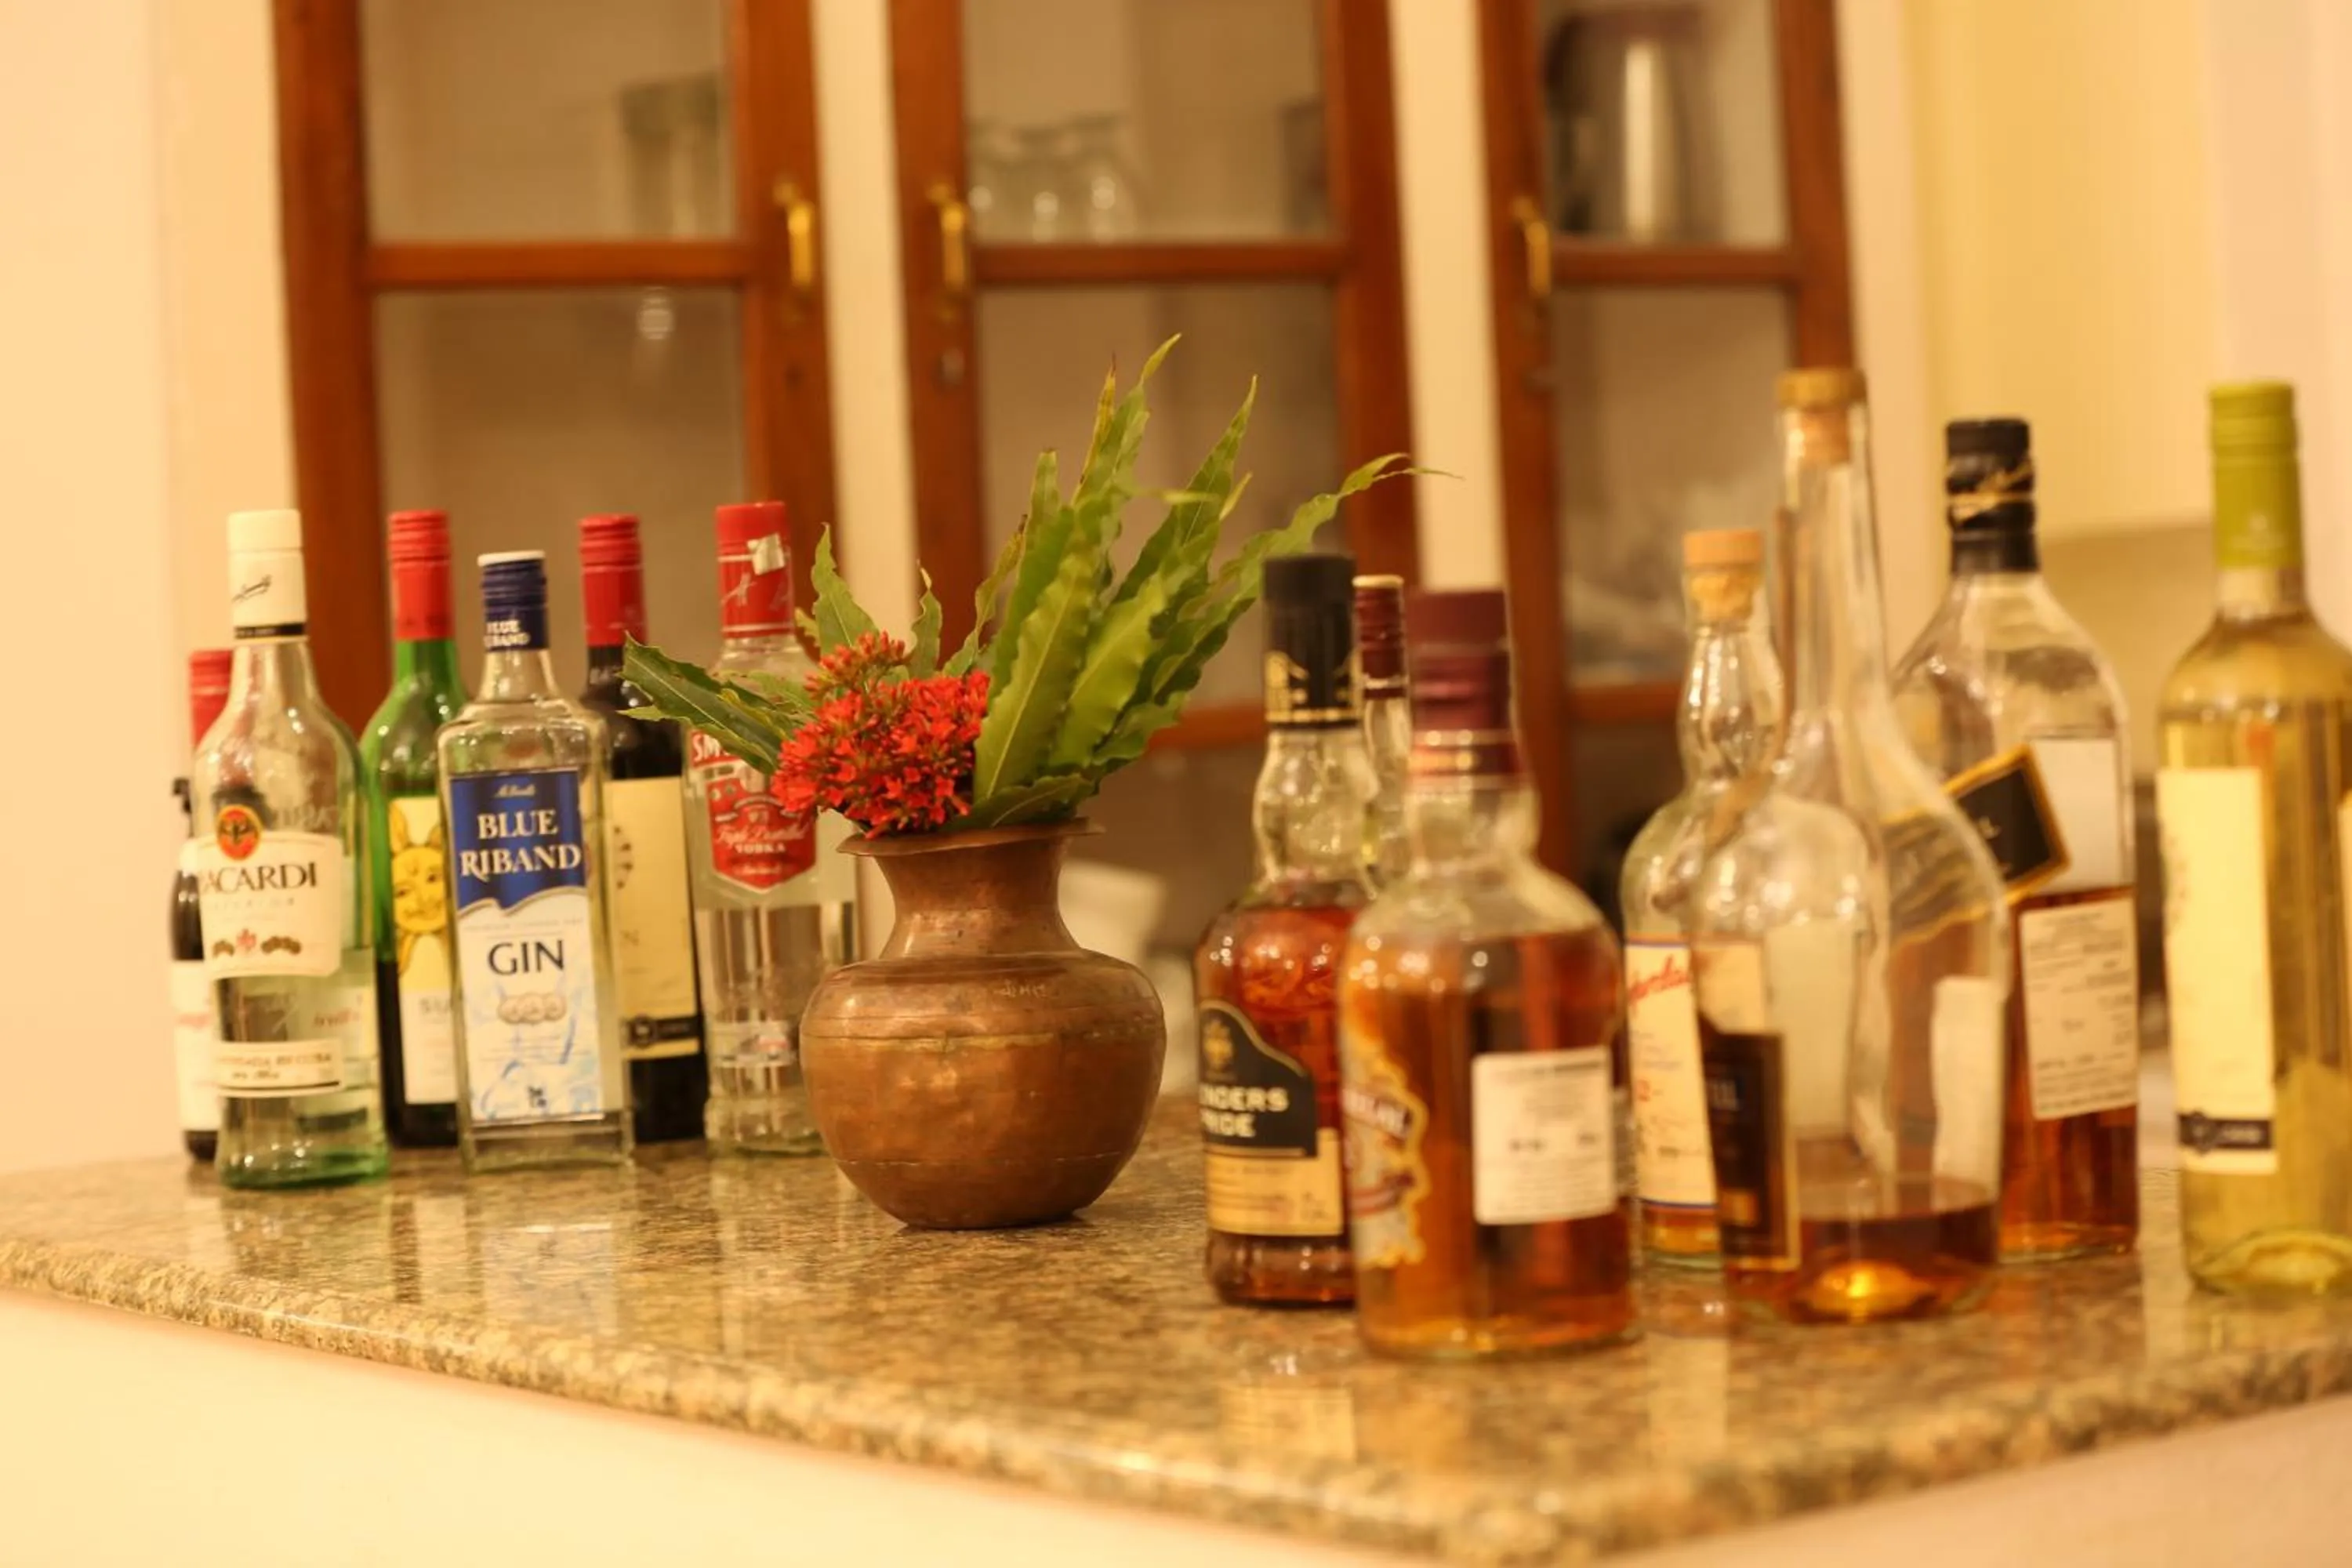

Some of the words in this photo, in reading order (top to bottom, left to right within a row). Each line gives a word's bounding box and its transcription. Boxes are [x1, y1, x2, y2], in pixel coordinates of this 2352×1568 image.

[477, 809, 559, 840] BLUE
[201, 861, 317, 895] ACARDI
[459, 843, 582, 883] RIBAND
[488, 939, 564, 976] GIN
